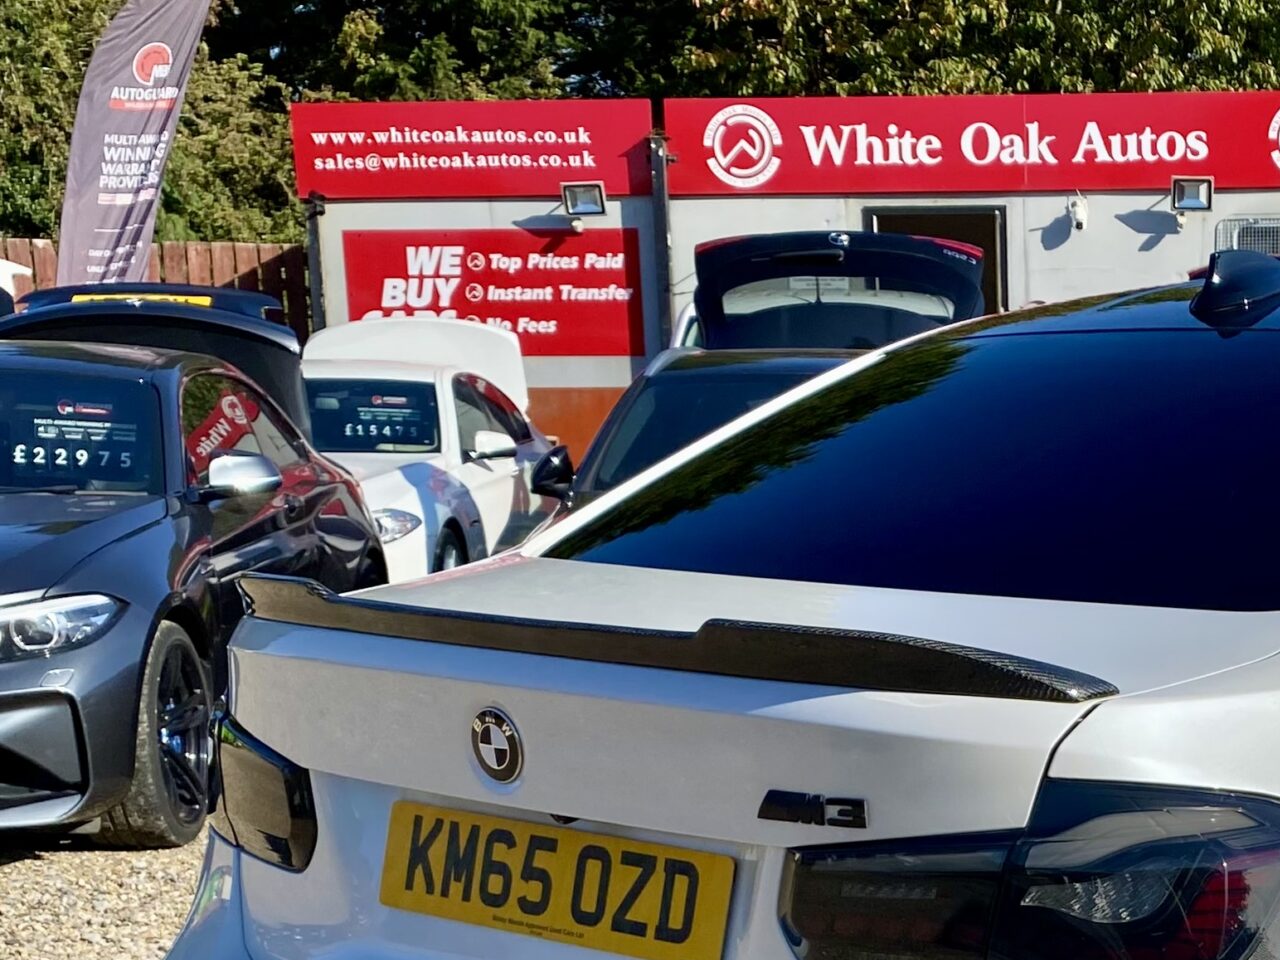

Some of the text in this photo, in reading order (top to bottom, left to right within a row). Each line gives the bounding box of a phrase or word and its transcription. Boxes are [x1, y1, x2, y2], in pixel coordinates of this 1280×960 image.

[111, 86, 178, 99] AUTOGUARD
[311, 126, 591, 145] www.whiteoakautos.co.uk
[800, 120, 1208, 167] White Oak Autos
[104, 143, 166, 161] WINNIG
[314, 151, 596, 170] sales@whiteoakautos.co.uk
[406, 246, 464, 276] WE
[488, 253, 625, 274] Top Prices Paid
[381, 278, 461, 308] BUY
[487, 285, 633, 301] Instant Transfer
[517, 317, 556, 333] Fees
[13, 444, 132, 468] £22975
[775, 789, 869, 829] M3
[404, 814, 699, 944] KM65 OZD
